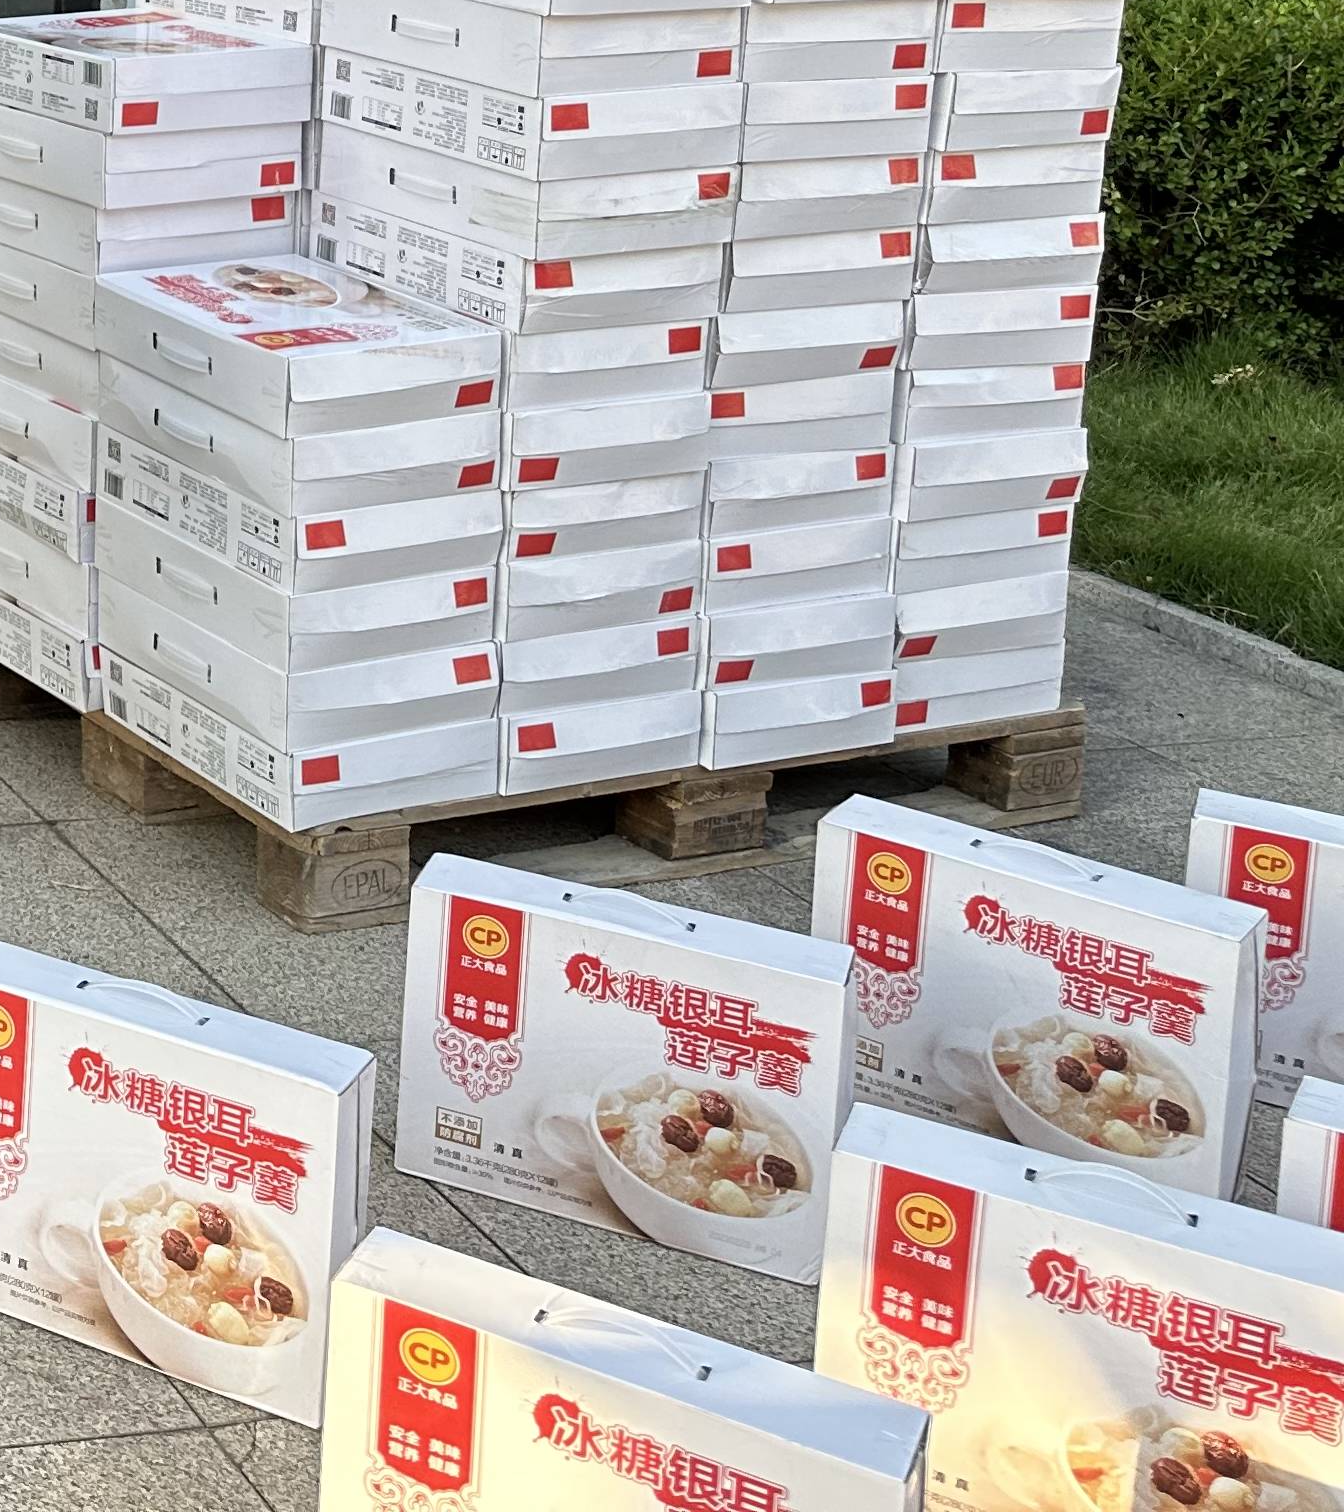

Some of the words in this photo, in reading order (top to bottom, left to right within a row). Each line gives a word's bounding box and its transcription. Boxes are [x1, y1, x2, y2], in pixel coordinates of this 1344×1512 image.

[873, 862, 906, 883] CP
[1253, 851, 1287, 873] CP
[344, 868, 392, 900] EPAL
[1242, 881, 1292, 900] 正大食品
[864, 890, 909, 913] 正大食品
[469, 927, 502, 948] CP
[978, 903, 1154, 987] 冰糖银耳
[461, 955, 507, 976] 正大食品
[578, 961, 758, 1036] 冰糖银耳
[1060, 973, 1198, 1045] 莲子羹
[665, 1029, 803, 1097] 莲子羹
[81, 1056, 255, 1146] 冰糖银耳
[165, 1133, 300, 1214] 莲子羹
[905, 1207, 946, 1234] CP
[892, 1240, 952, 1271] 正大食品
[1046, 1261, 1284, 1367] 冰糖银耳
[410, 1343, 450, 1368] CP
[398, 1378, 459, 1410] 正大食品
[1159, 1353, 1343, 1447] 莲子羹
